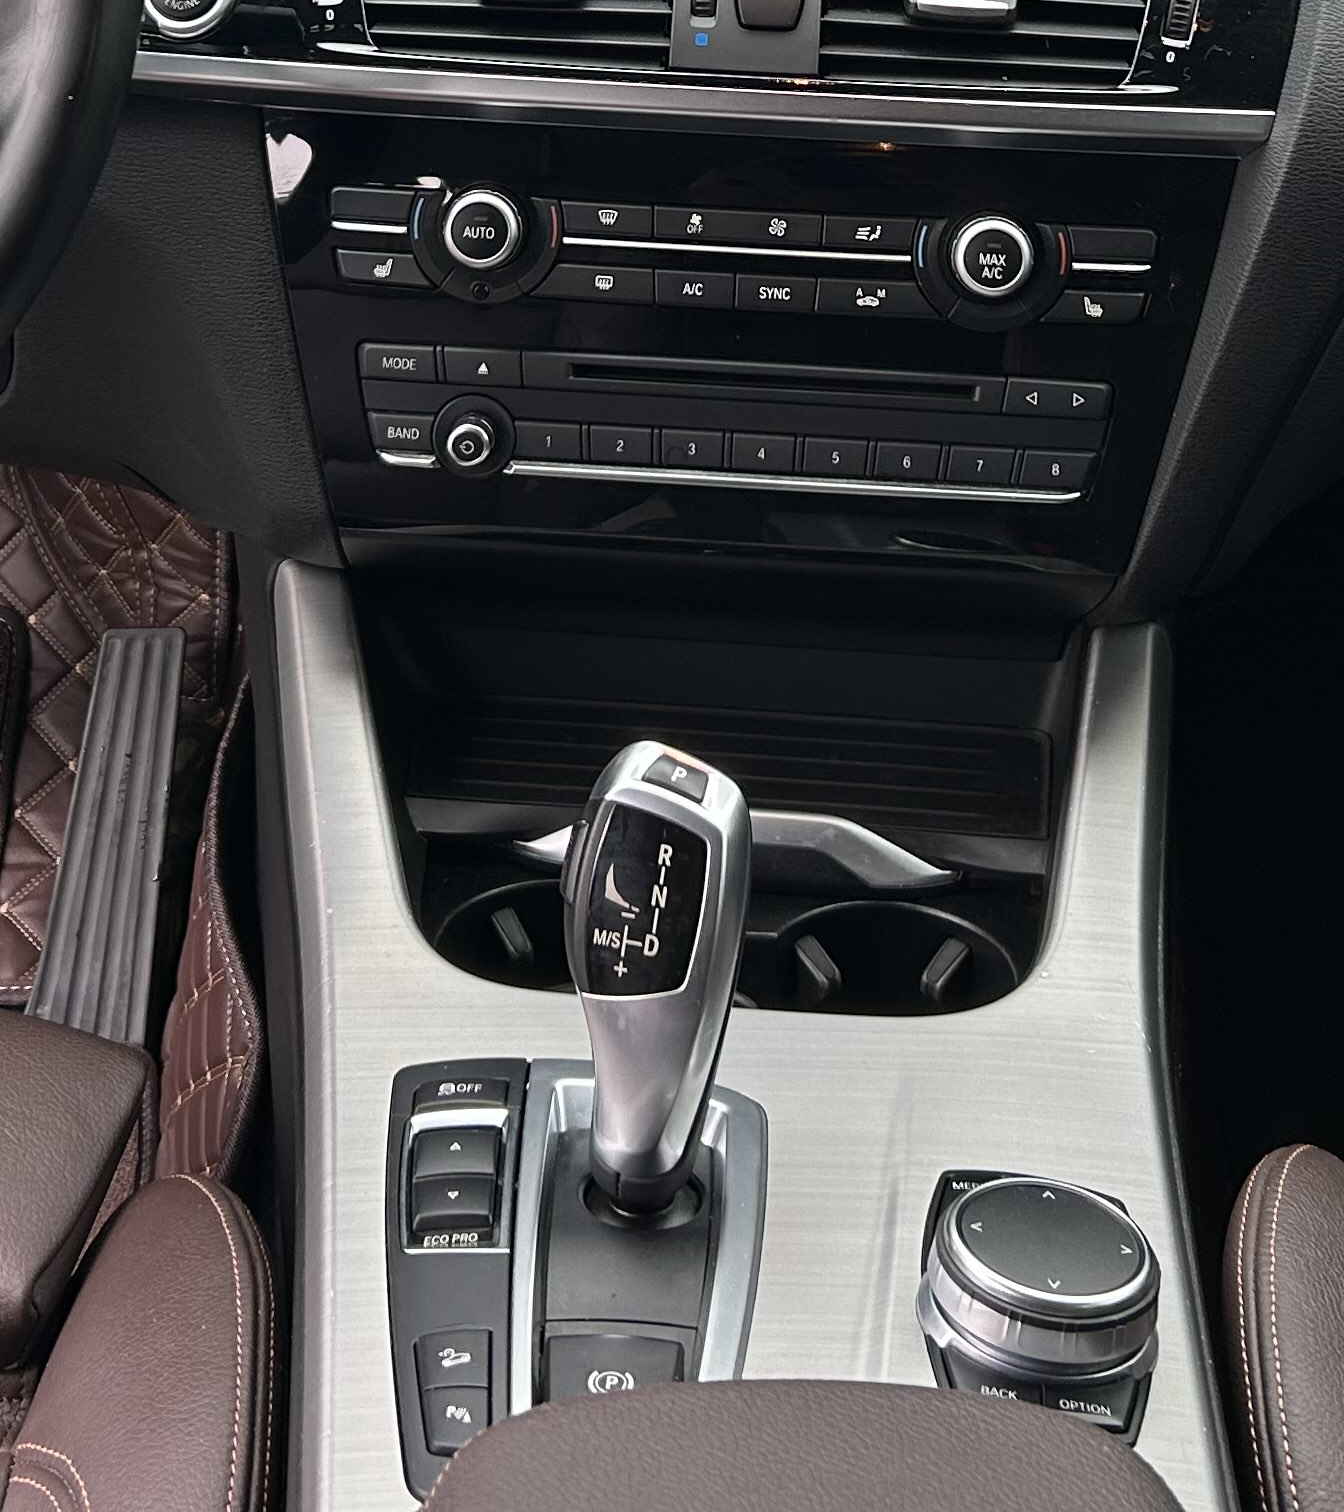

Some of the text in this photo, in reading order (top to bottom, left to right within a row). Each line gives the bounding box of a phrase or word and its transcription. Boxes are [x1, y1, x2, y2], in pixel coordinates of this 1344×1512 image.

[462, 225, 495, 239] AUTO
[687, 224, 703, 234] OFF
[979, 252, 1006, 266] MAX
[981, 266, 1003, 280] A/C
[682, 282, 703, 296] A/C
[759, 287, 791, 301] SYNC
[382, 357, 417, 370] MODE
[387, 426, 420, 440] BAND
[616, 439, 624, 452] 2
[688, 442, 696, 456] 3
[757, 447, 766, 460] 4
[831, 451, 840, 465] 5
[903, 455, 911, 469] 6
[976, 459, 984, 473] 7
[1051, 463, 1060, 477] 8
[671, 766, 687, 782] P
[658, 844, 673, 867] R
[651, 885, 668, 909] N
[593, 928, 621, 948] M/S
[643, 934, 660, 957] D
[456, 1083, 484, 1094] OFF
[423, 1232, 479, 1248] ECO PRO
[980, 1384, 1018, 1401] BACK
[1059, 1398, 1112, 1417] OPTION
